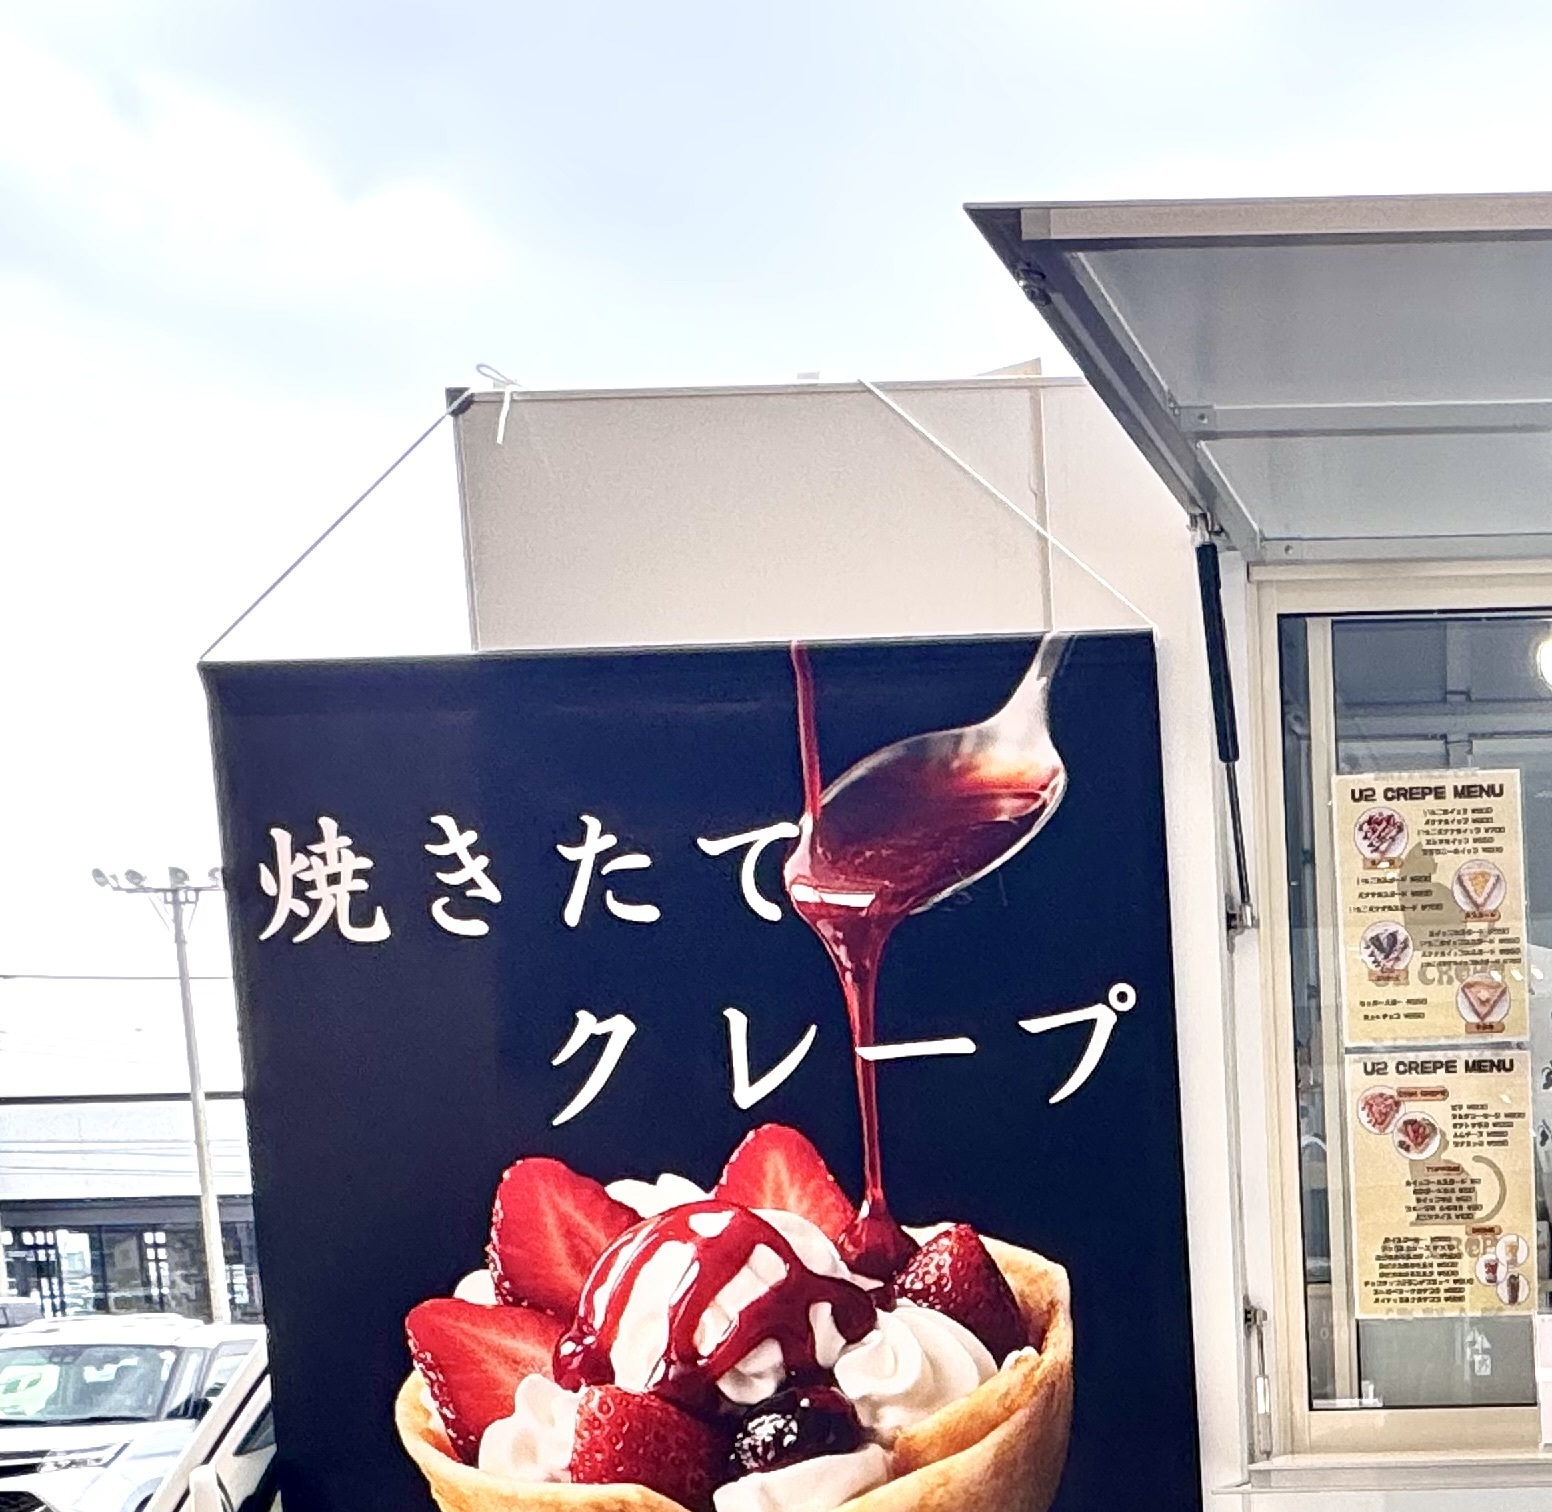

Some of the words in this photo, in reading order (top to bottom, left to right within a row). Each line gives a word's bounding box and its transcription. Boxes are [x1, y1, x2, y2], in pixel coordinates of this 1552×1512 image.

[1351, 787, 1376, 802] U2
[1383, 785, 1446, 801] CREPE
[1453, 784, 1504, 799] MENU
[258, 814, 804, 945] 焼きたて
[551, 981, 1138, 1127] クレープ
[1363, 1061, 1388, 1076] U2
[1395, 1059, 1458, 1074] CREPE
[1464, 1058, 1514, 1073] MENU
